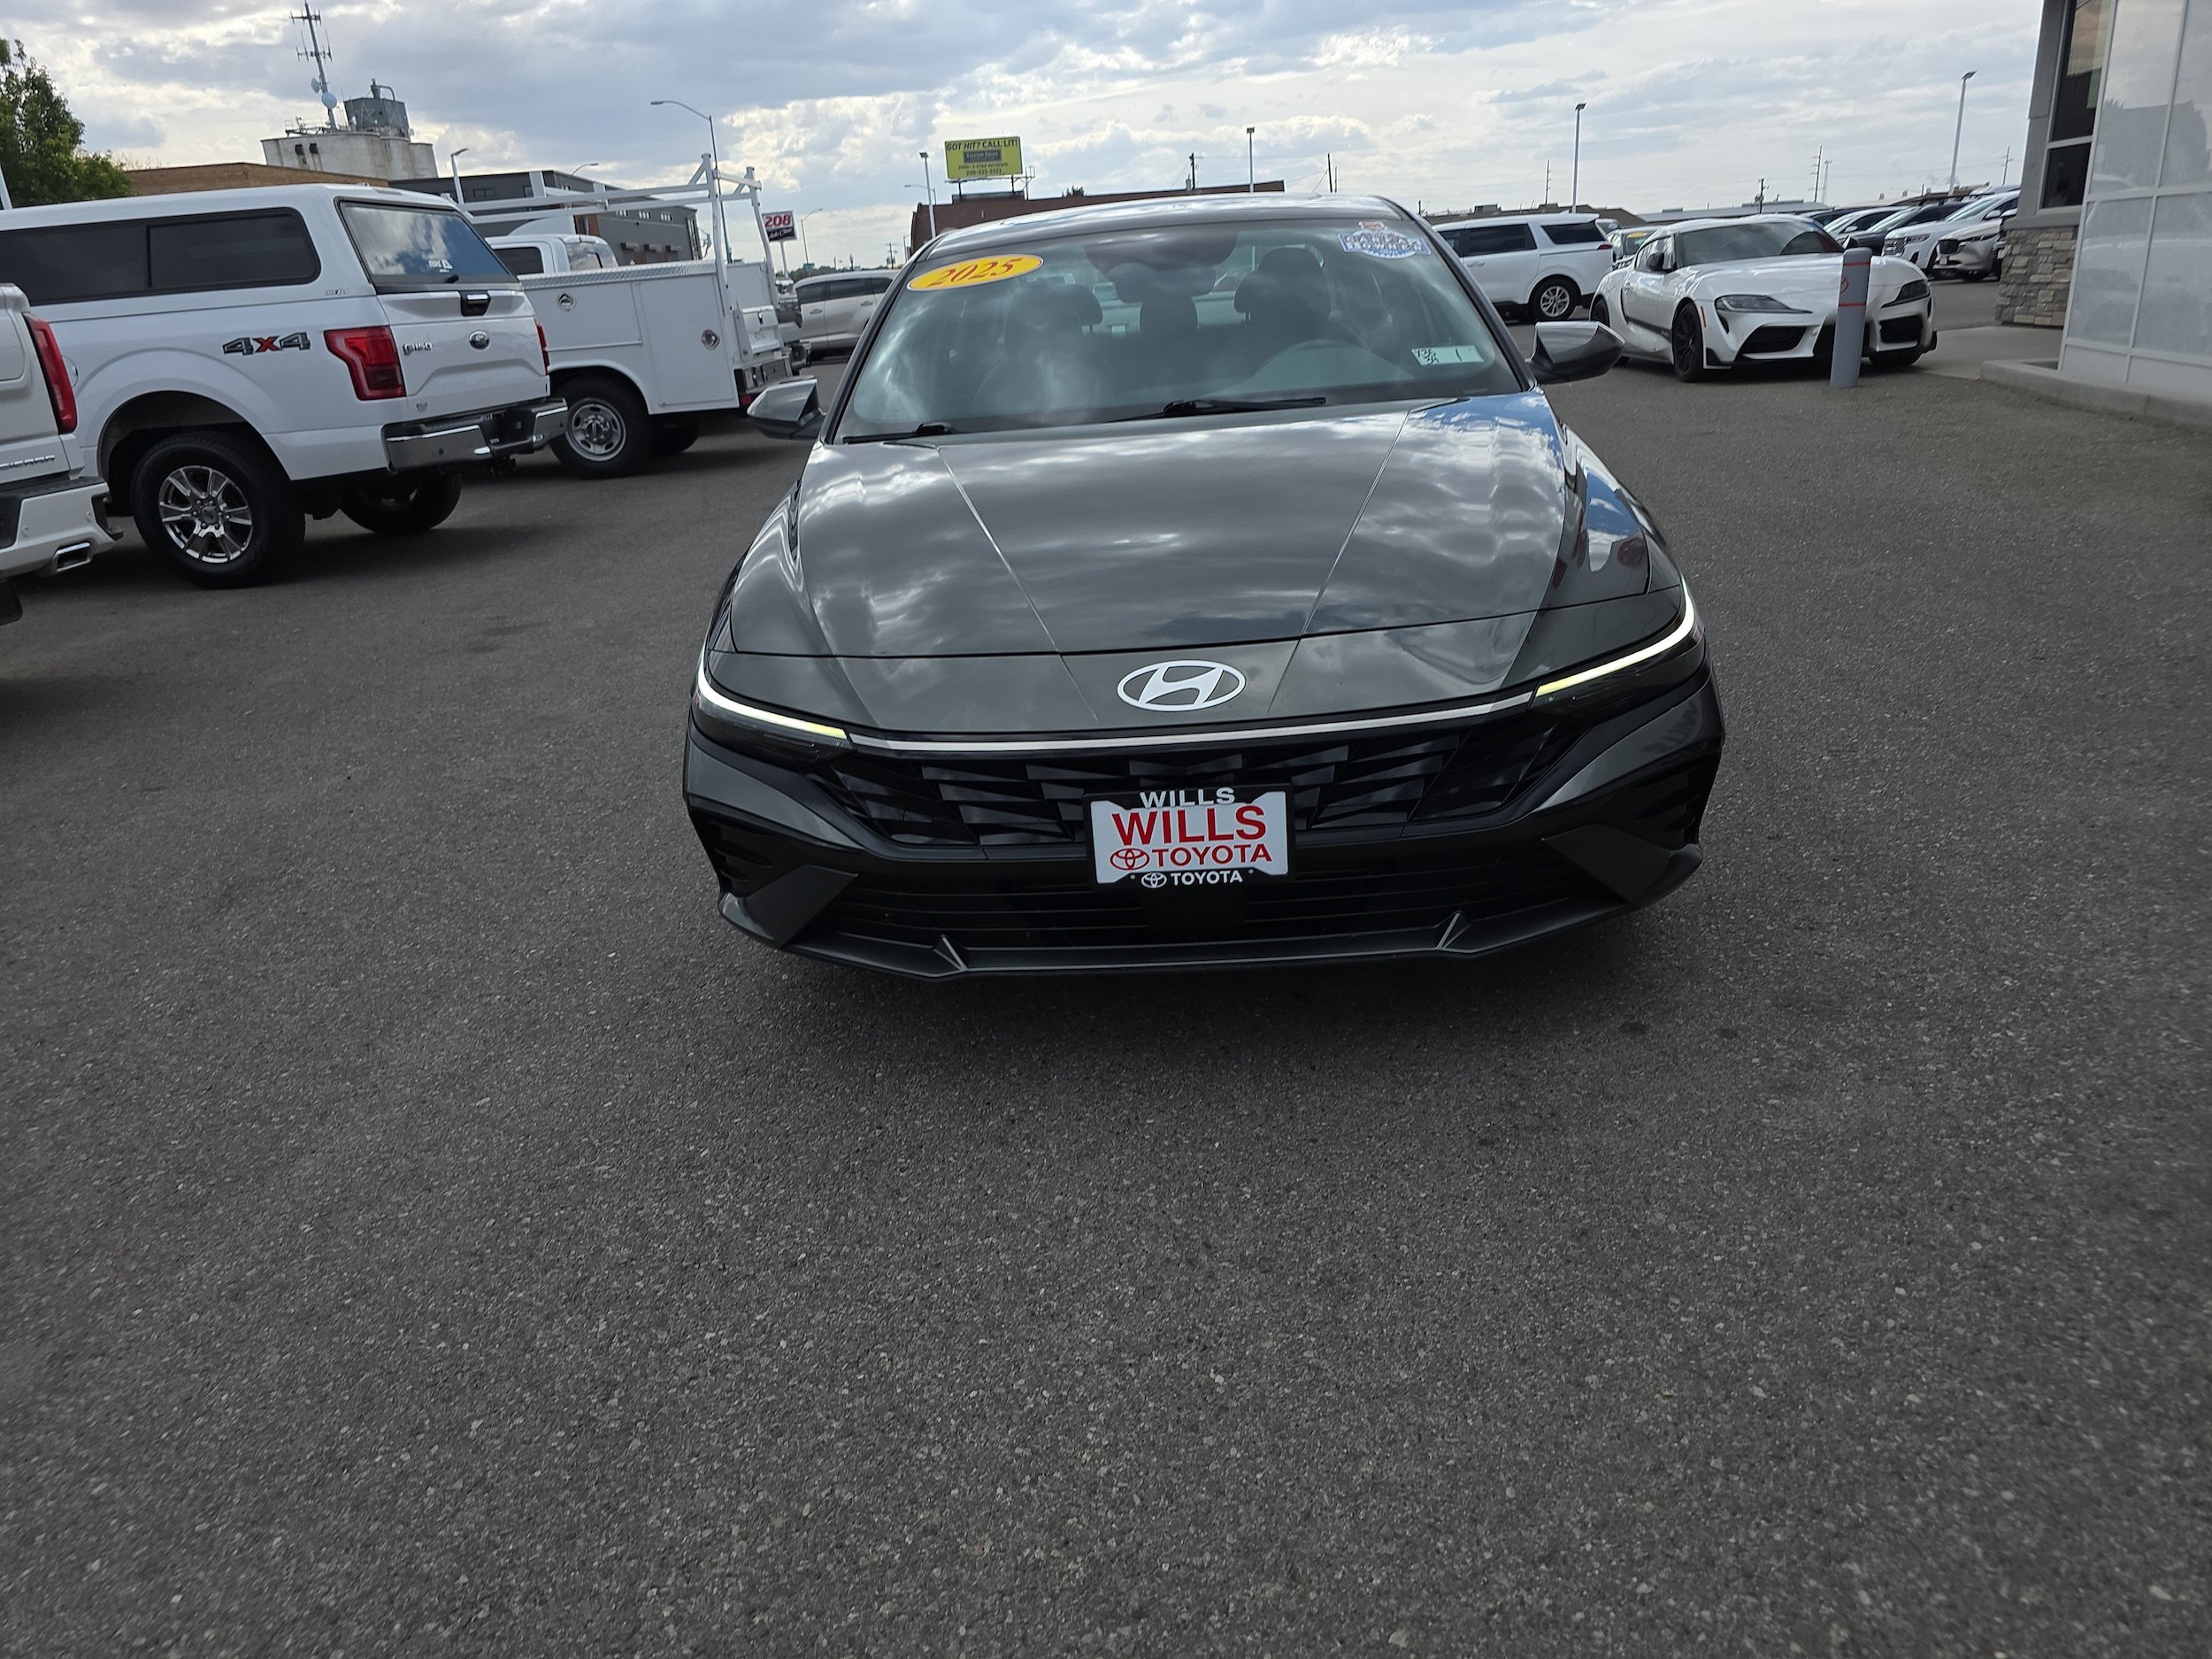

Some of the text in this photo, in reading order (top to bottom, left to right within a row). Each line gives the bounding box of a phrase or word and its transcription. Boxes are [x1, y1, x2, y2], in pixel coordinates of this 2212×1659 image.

[765, 215, 790, 227] 208
[926, 257, 1024, 288] 2025
[1140, 787, 1235, 809] WILLS
[1111, 805, 1267, 846] WILLS
[1151, 843, 1272, 867] TOYOTA
[1170, 869, 1243, 886] TOYOTA
